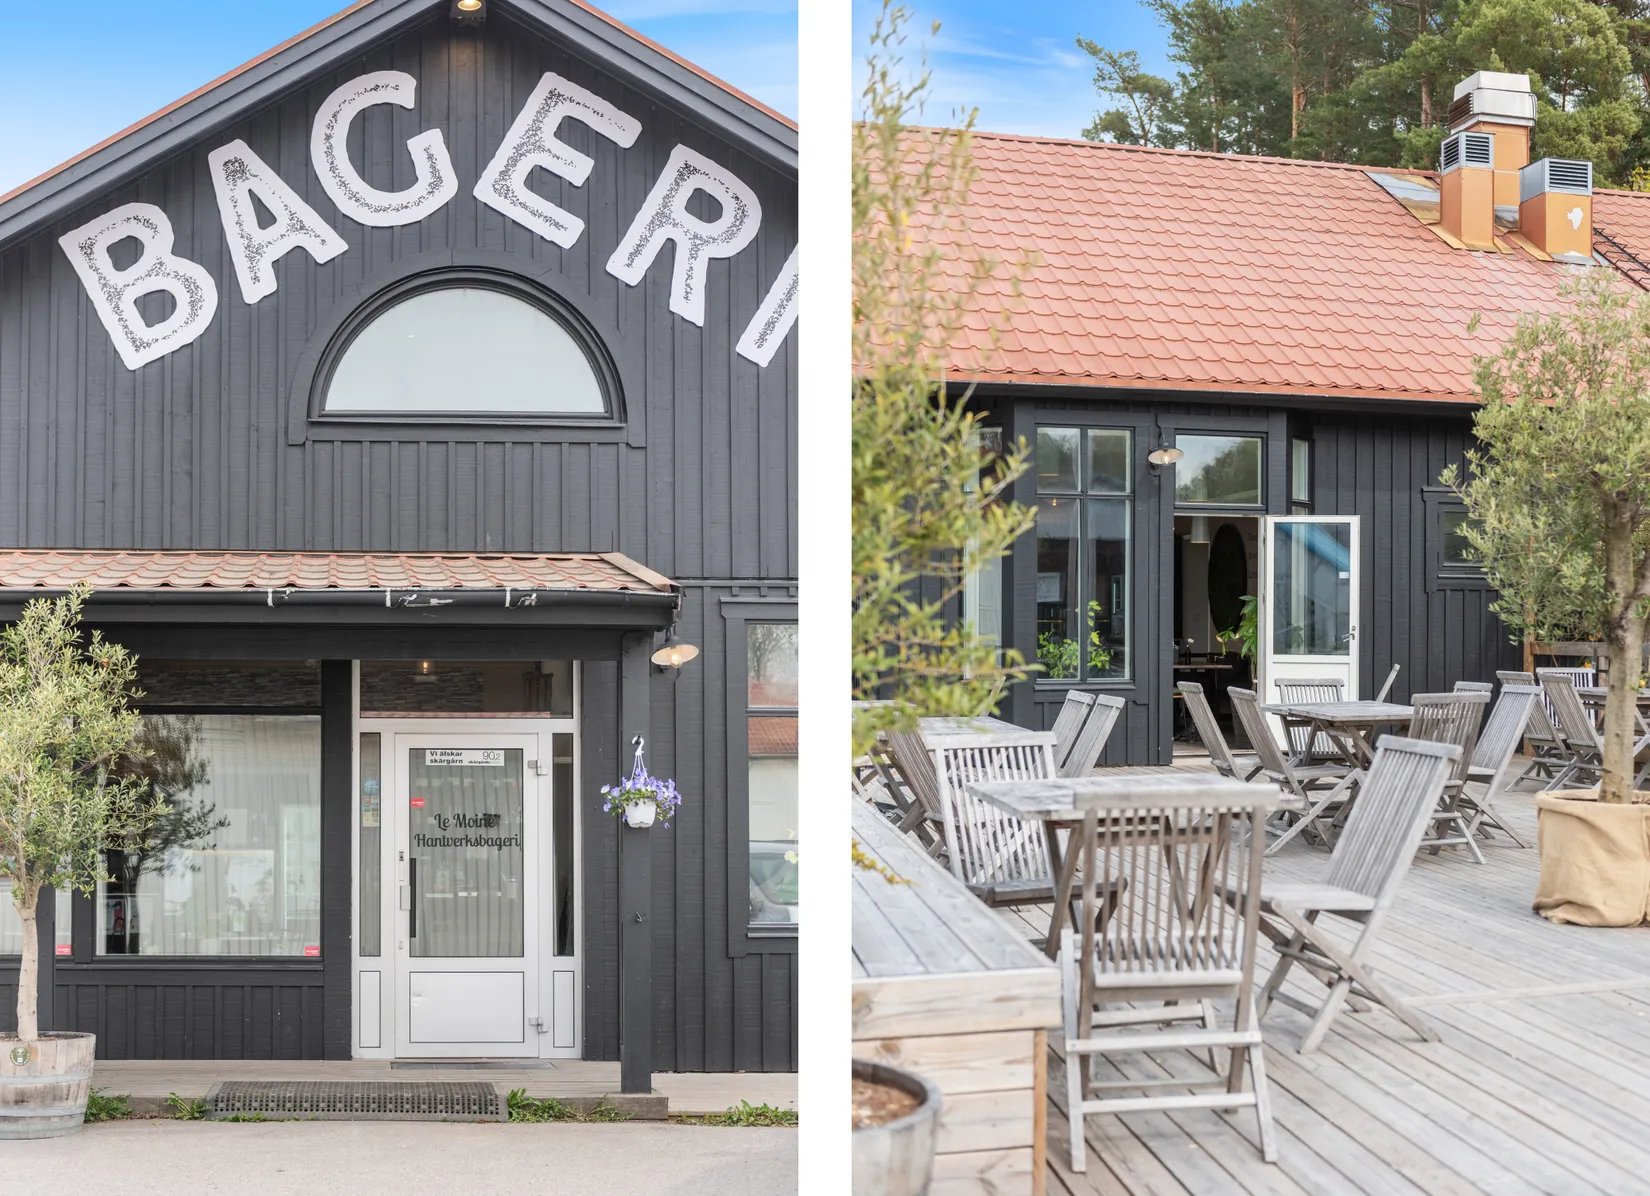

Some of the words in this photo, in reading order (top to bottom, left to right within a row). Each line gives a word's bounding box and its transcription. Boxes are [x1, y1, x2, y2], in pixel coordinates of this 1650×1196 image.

[434, 813, 451, 831] Le
[453, 813, 498, 829] Moine
[413, 833, 520, 851] Hantverksbageri
